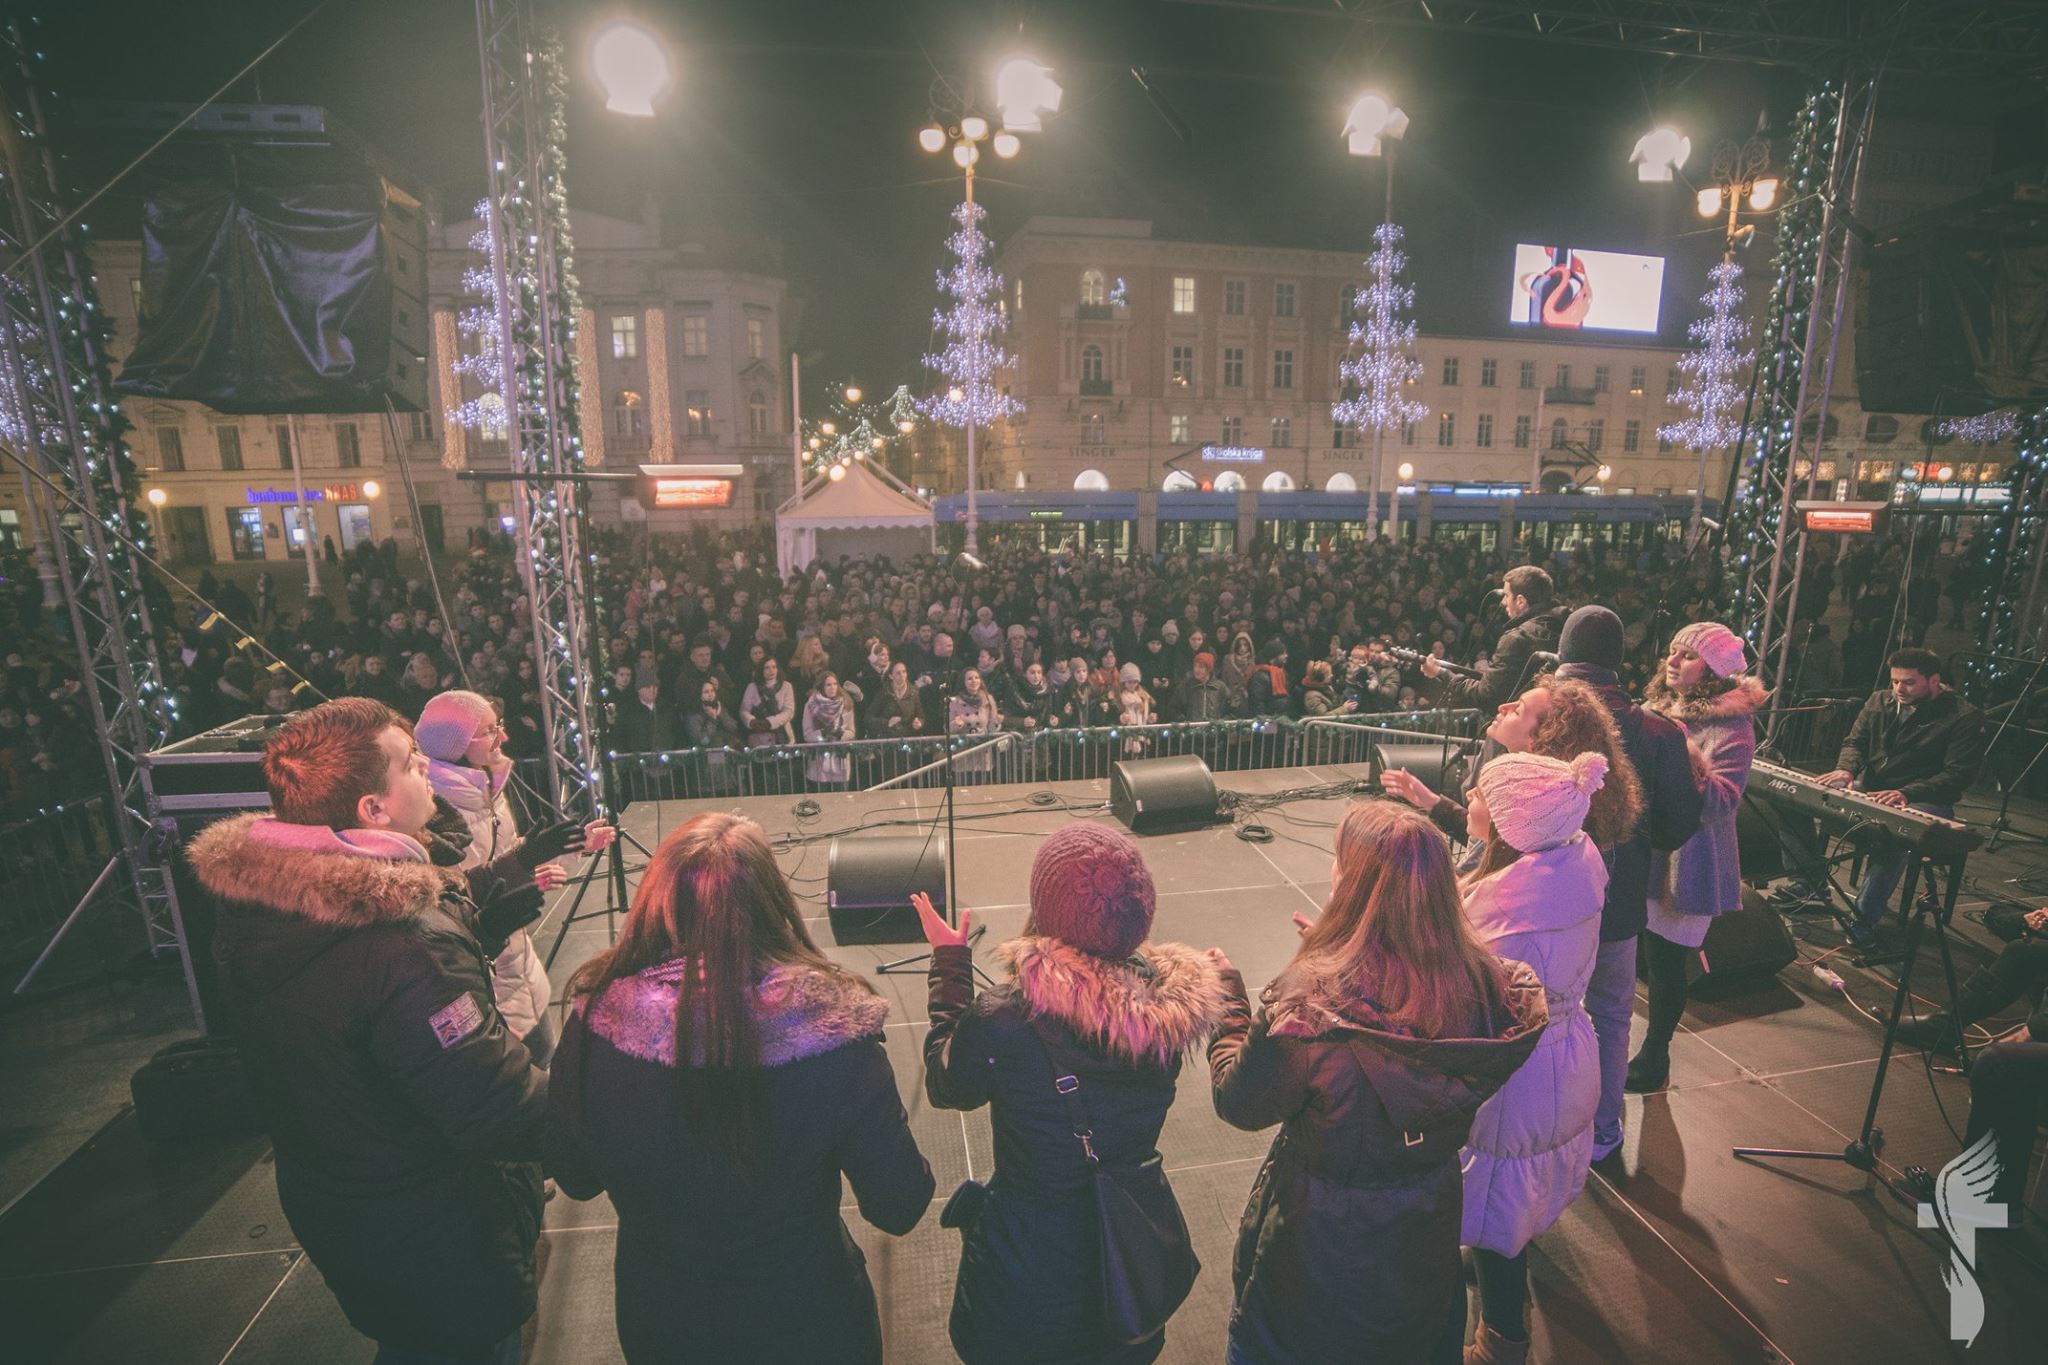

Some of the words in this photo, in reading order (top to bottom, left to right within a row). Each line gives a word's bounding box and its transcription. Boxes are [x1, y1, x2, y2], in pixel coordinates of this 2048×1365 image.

[1069, 447, 1116, 457] SINGER
[1322, 449, 1364, 460] SINGER
[1768, 779, 1797, 793] MP6
